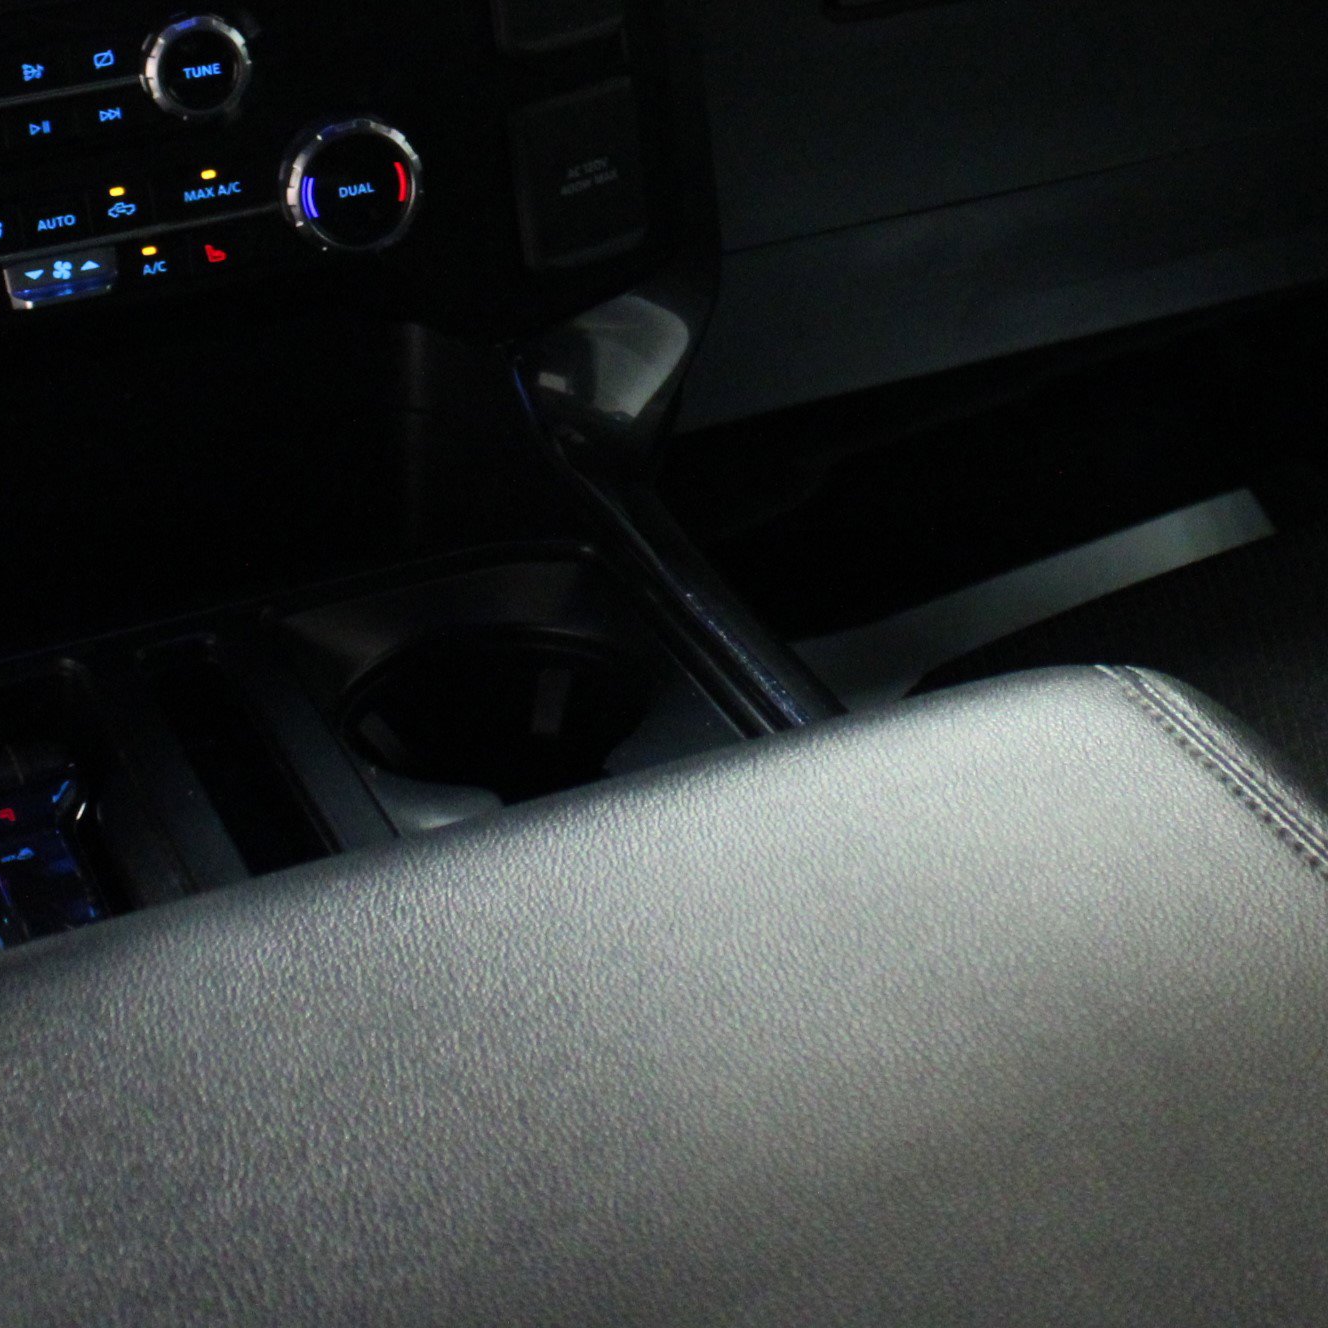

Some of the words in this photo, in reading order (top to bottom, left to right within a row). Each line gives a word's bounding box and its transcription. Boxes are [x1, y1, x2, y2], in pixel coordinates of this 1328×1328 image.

[182, 62, 223, 80] TUNE
[183, 186, 215, 203] MAX
[217, 181, 242, 197] A/C
[338, 182, 376, 199] DUAL
[37, 214, 76, 232] AUTO
[143, 260, 168, 276] A/C
